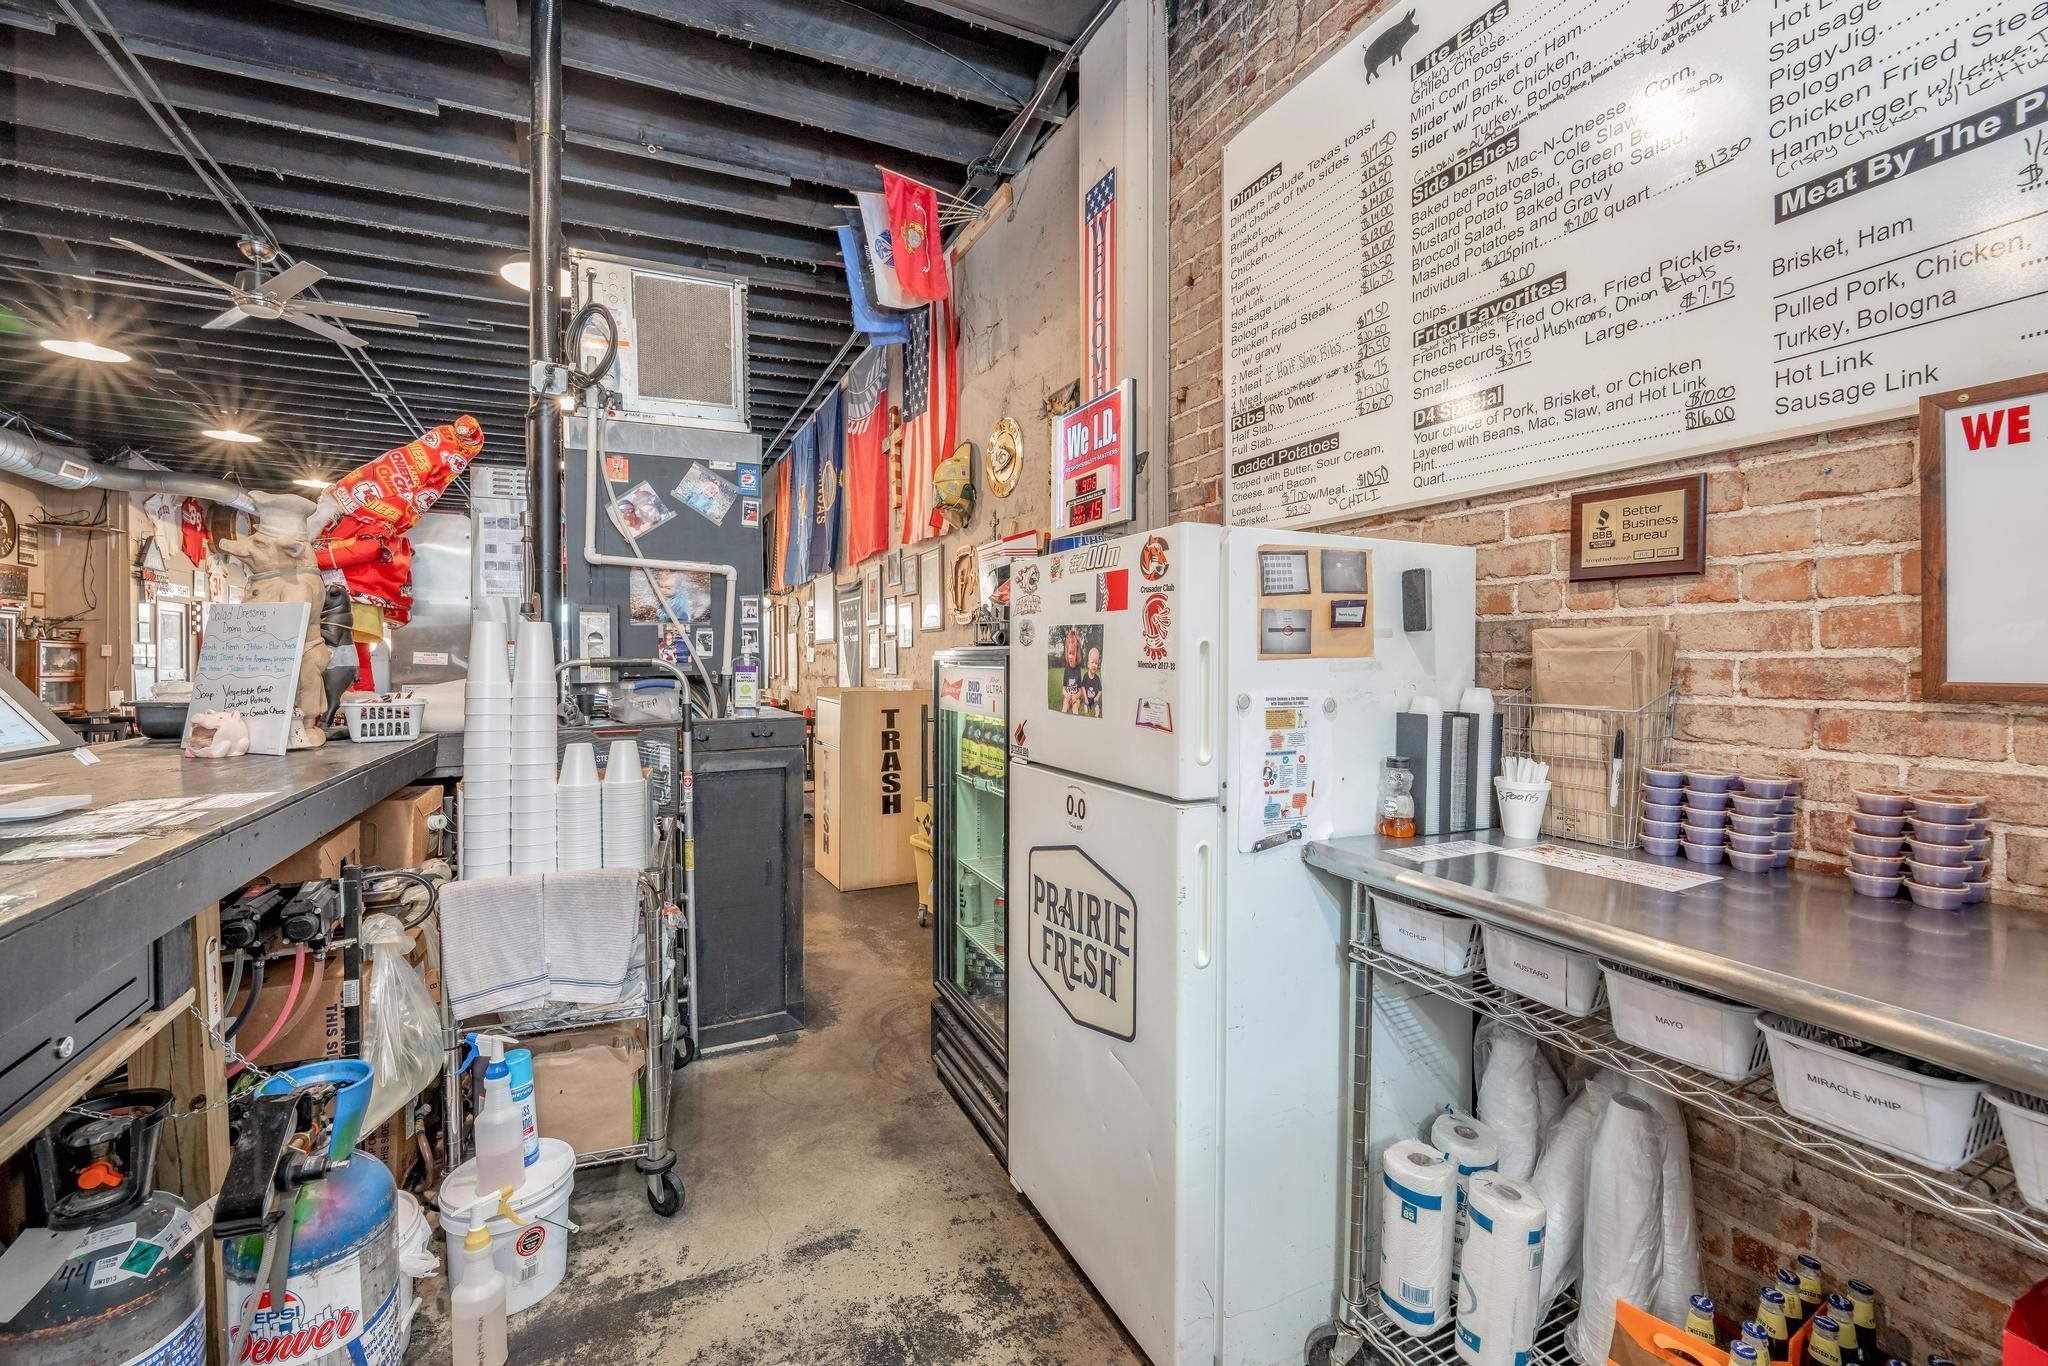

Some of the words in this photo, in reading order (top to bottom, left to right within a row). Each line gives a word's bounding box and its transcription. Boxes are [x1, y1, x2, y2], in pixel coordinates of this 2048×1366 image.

[1412, 45, 1450, 80] Lite
[1458, 3, 1508, 48] Eats
[1410, 100, 1434, 124] Mini
[1439, 79, 1469, 104] Corn
[1474, 53, 1509, 82] Dogs
[1411, 72, 1449, 104] Grilled
[1454, 36, 1505, 75] Cheese
[1412, 112, 1448, 140] Slider
[1472, 65, 1519, 102] Brisket
[1545, 26, 1582, 56] Ham
[1528, 61, 1592, 107] Bologna
[1770, 56, 1872, 115] Bologna
[1770, 83, 1871, 140] Chicken
[1882, 39, 1958, 90] Fried
[1412, 130, 1448, 158] Slider
[1513, 52, 1579, 96] Chicken,
[1772, 90, 1918, 166] Hamburger
[1230, 198, 1265, 228] Dinners
[1268, 170, 1304, 202] include
[1307, 145, 1340, 172] Texas
[1344, 119, 1376, 147] toast
[1412, 173, 1449, 205] Side
[1454, 136, 1517, 182] Dishes
[1782, 168, 1858, 216] Meat
[1925, 116, 2002, 158] The
[1232, 166, 1282, 210] Dinners
[1250, 202, 1280, 227] choice
[1296, 178, 1315, 195] two
[1319, 154, 1350, 180] sides
[1412, 200, 1472, 240] Scalloped
[1476, 167, 1542, 207] Potatoes,
[1554, 140, 1590, 166] Cole
[1412, 222, 1460, 256] Mustard
[1465, 202, 1508, 230] Potato
[1514, 174, 1560, 205] Salad,
[1571, 142, 1623, 175] Green
[1412, 196, 1449, 225] Baked
[1412, 239, 1460, 272] Broccoli
[1464, 218, 1506, 246] Salad,
[1516, 188, 1563, 221] Baked
[1570, 161, 1623, 195] Potato
[1230, 229, 1262, 254] Brisket
[1230, 246, 1258, 268] Pulled
[1262, 227, 1284, 247] Pork
[1412, 254, 1460, 286] Mashed
[1465, 226, 1524, 262] Potatoes
[1530, 207, 1557, 231] and
[1563, 184, 1613, 215] Gravy
[1412, 267, 1469, 302] Individual
[1604, 186, 1650, 218] quart
[1772, 238, 1849, 277] Brisket,
[1858, 216, 1913, 248] Ham
[1230, 252, 1268, 280] Chicken
[1775, 288, 1838, 322] Pulled
[1916, 234, 2032, 280] Chicken,
[1231, 284, 1262, 306] Turkey
[1413, 342, 1456, 366] French
[1506, 307, 1544, 332] Fried
[1551, 293, 1596, 316] Okra,
[1604, 267, 1650, 297] Fried
[1660, 240, 1741, 277] Pickles,
[1413, 303, 1448, 326] Chips
[1414, 315, 1460, 348] Fried
[1467, 276, 1565, 327] Favorites
[1231, 304, 1272, 332] Sausage
[1231, 334, 1268, 359] Chicken
[1272, 320, 1297, 340] Fried
[1300, 302, 1332, 324] Steak
[1231, 322, 1269, 346] Bologna
[1586, 319, 1638, 345] Large
[1774, 319, 1850, 350] Turkey,
[1858, 289, 1957, 329] Bologna
[1413, 344, 1506, 383] Cheesecurds,
[1775, 364, 1812, 388] Hot
[1820, 350, 1874, 378] Link
[1413, 379, 1448, 400] Small
[1414, 428, 1440, 444] Your
[1544, 384, 1600, 410] Brisket,
[1606, 380, 1622, 394] or
[1628, 358, 1702, 387] Chicken
[1775, 381, 1876, 415] Sausage
[1886, 364, 1938, 392] Link
[1067, 422, 1089, 461] We
[1094, 408, 1118, 450] I.D.
[1232, 426, 1250, 444] Half
[1253, 422, 1274, 436] Slab
[1233, 410, 1264, 430] Ribs
[1412, 441, 1454, 461] Layered
[1458, 434, 1478, 449] with
[1483, 425, 1524, 442] Beans,
[1606, 394, 1633, 412] and
[1640, 386, 1666, 403] Hot
[1673, 376, 1706, 395] Link
[1960, 405, 2030, 451] WE
[1232, 453, 1275, 477] Loaded
[1278, 437, 1339, 464] Potatoes
[1251, 437, 1272, 450] Slab
[1232, 475, 1261, 491] Topped
[1316, 454, 1340, 468] Sour
[1344, 444, 1384, 462] Cream,
[1286, 475, 1316, 490] Bacon
[1413, 458, 1434, 474] Pint
[1414, 472, 1446, 488] Quart
[1232, 502, 1262, 517] Loaded
[1622, 504, 1662, 516] Better
[1622, 515, 1678, 530] Business
[1592, 531, 1612, 540] BBB
[1622, 530, 1668, 542] Bureau
[1140, 584, 1161, 594] Crusader
[1162, 584, 1174, 592] Club
[1138, 660, 1157, 670] Member
[966, 692, 982, 704] LIGHT
[968, 680, 980, 692] BUD
[881, 709, 902, 815] TRASH
[1066, 794, 1086, 820] 0.0
[1034, 874, 1130, 957] PRAIRIE
[1399, 927, 1428, 942] KETCHUP
[1042, 925, 1117, 1002] FRESH
[1513, 960, 1549, 980] MUSTARD
[326, 1004, 338, 1038] THIS
[1656, 1016, 1684, 1029] MAYO
[1806, 1072, 1862, 1100] MIRACLE
[1863, 1093, 1901, 1110] WHIP
[380, 1122, 390, 1144] SIDE
[1404, 1210, 1414, 1221] 85
[58, 1260, 92, 1292] 44
[254, 1306, 300, 1324] EPSI
